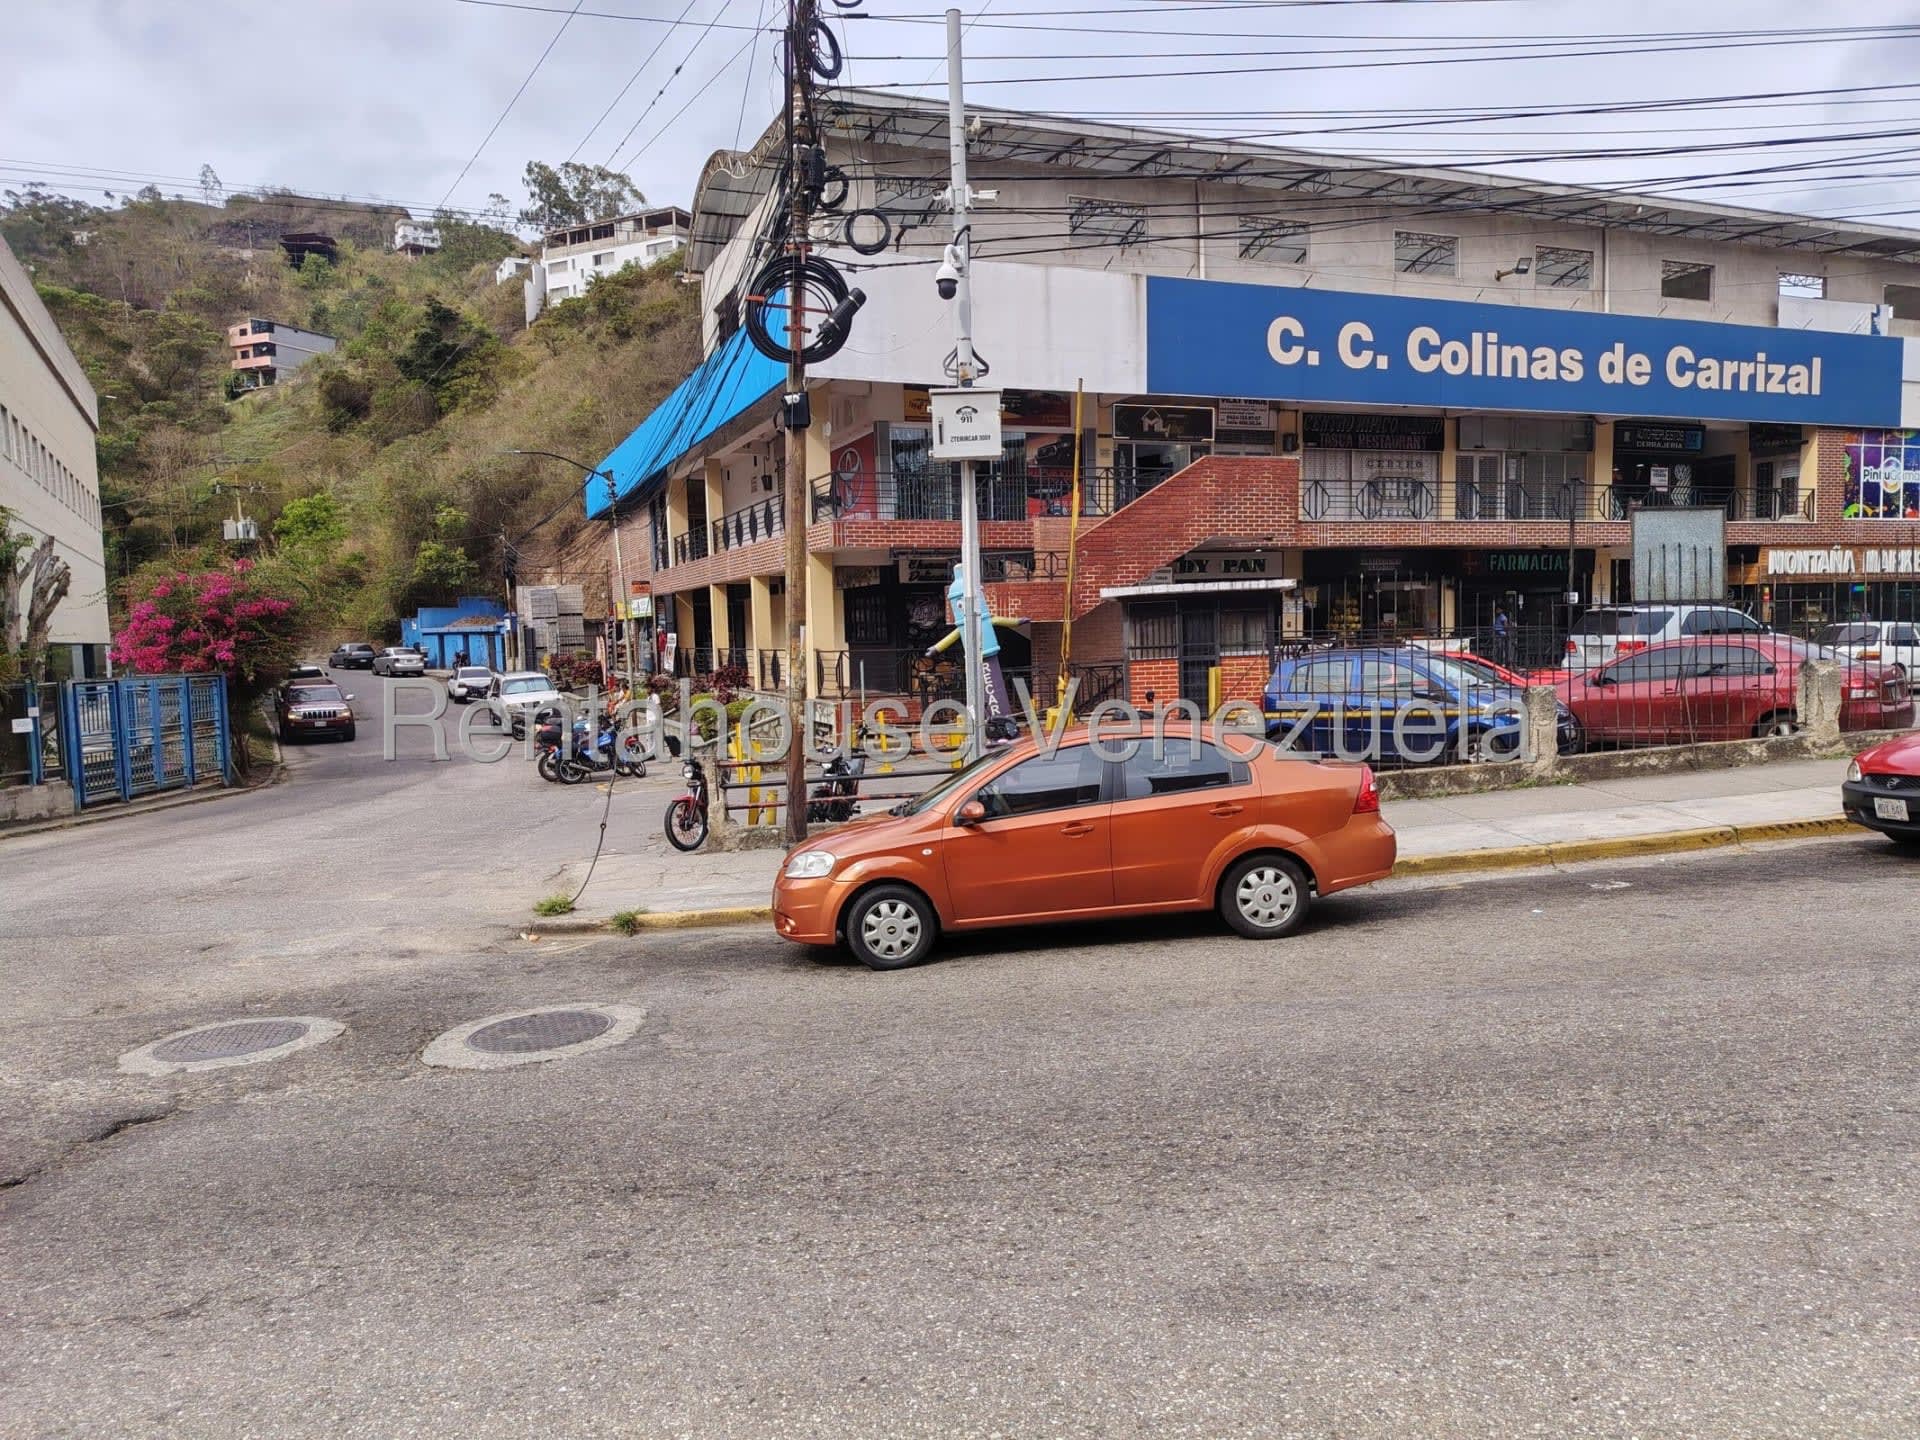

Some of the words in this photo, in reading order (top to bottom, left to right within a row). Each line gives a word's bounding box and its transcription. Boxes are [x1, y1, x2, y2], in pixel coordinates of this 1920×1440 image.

[1266, 315, 1320, 366] C.
[1337, 320, 1388, 370] C.
[1406, 325, 1584, 383] Colinas
[1598, 342, 1653, 386] de
[1665, 345, 1823, 396] Carrizal
[1223, 559, 1266, 573] PAN
[1768, 544, 1856, 575] MONTAÑA
